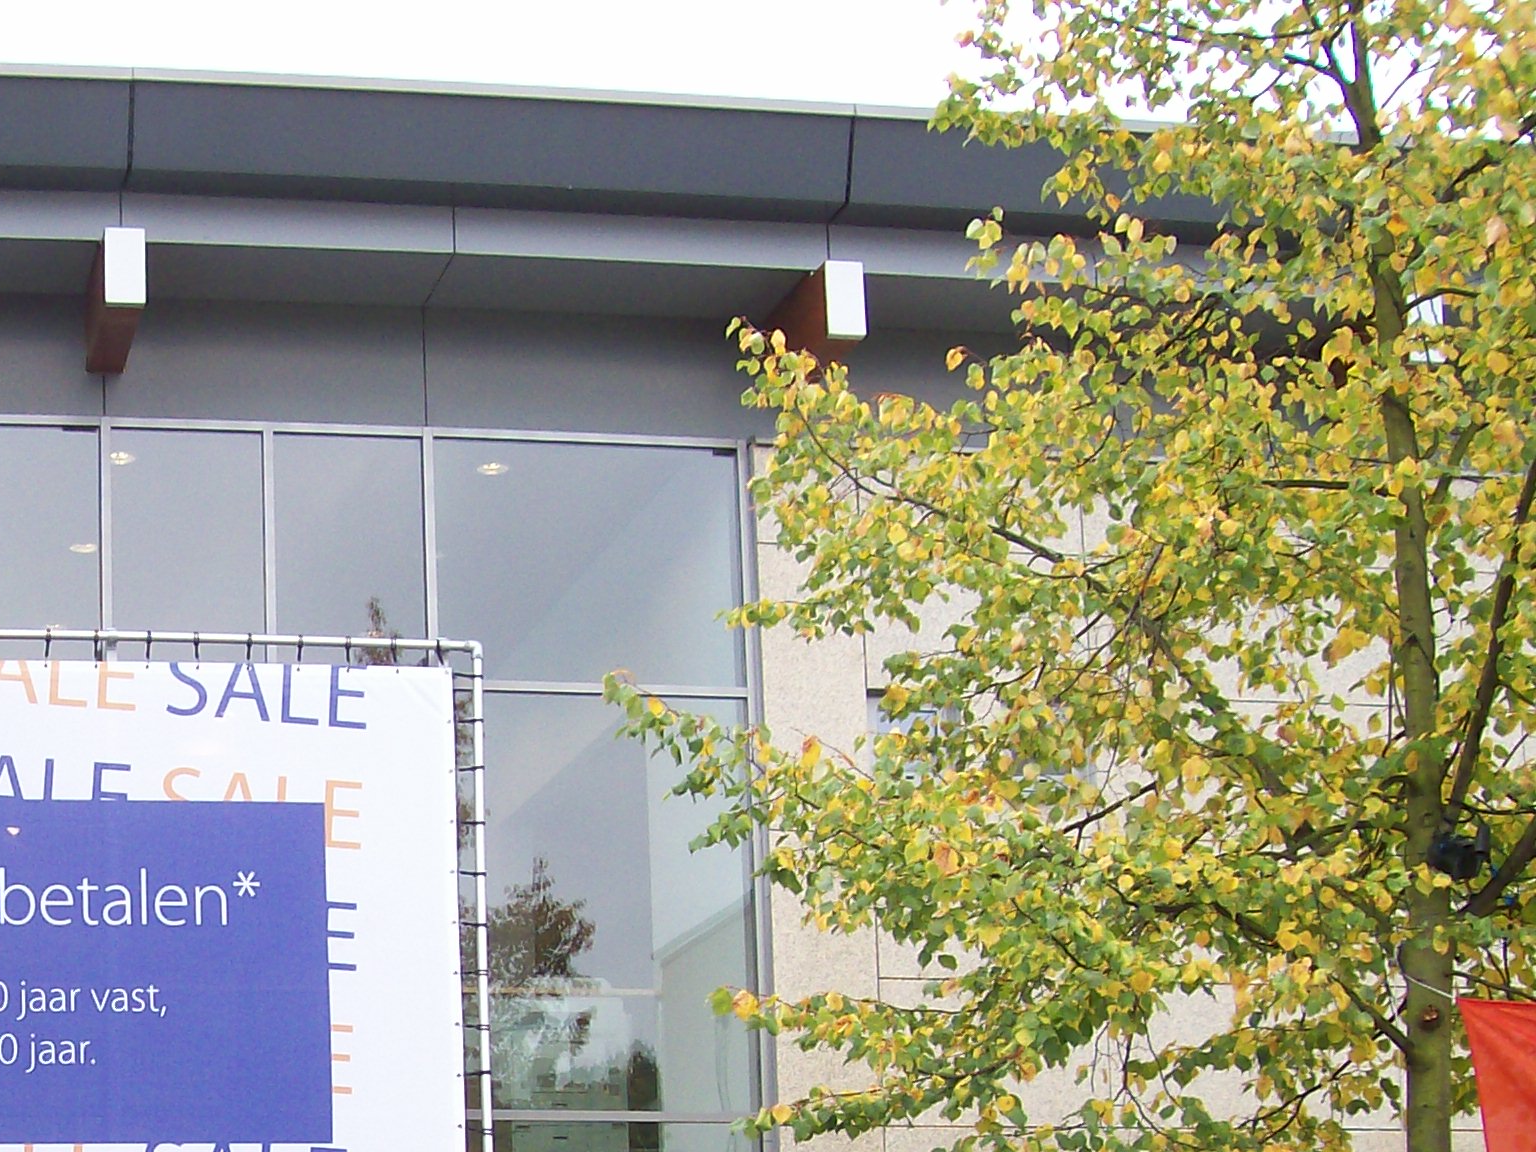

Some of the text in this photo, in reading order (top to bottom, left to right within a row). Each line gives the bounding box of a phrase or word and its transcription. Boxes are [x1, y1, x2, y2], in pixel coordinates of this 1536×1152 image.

[166, 661, 367, 730] SALE
[15, 979, 82, 1022] jaar
[90, 983, 167, 1018] vast,
[24, 1032, 97, 1074] jaar.
